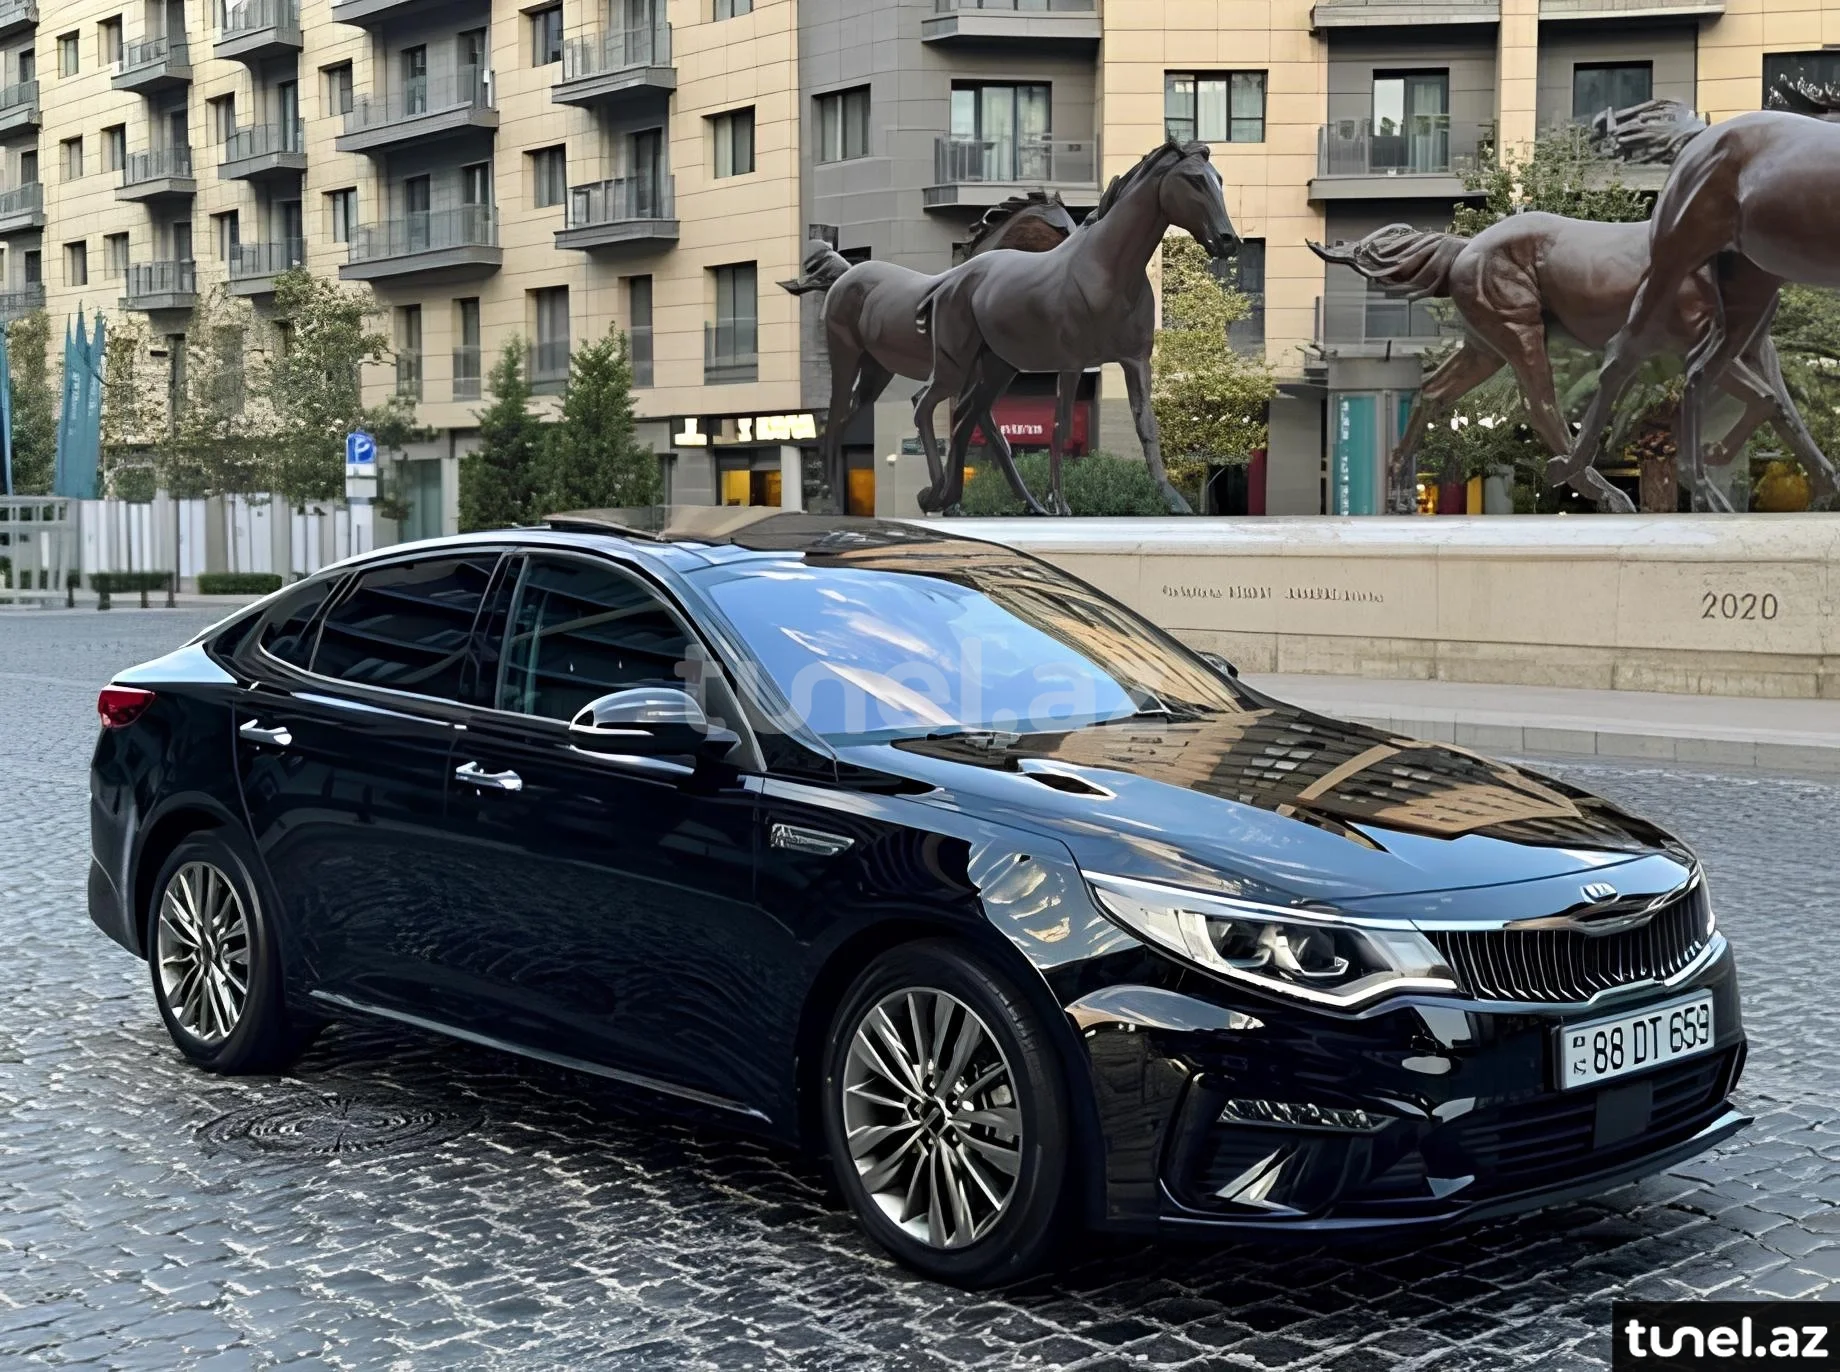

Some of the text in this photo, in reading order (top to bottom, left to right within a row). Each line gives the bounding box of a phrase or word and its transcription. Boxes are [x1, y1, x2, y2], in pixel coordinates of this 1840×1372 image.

[1701, 591, 1778, 620] 2020
[1593, 1004, 1710, 1074] 88 DT 659
